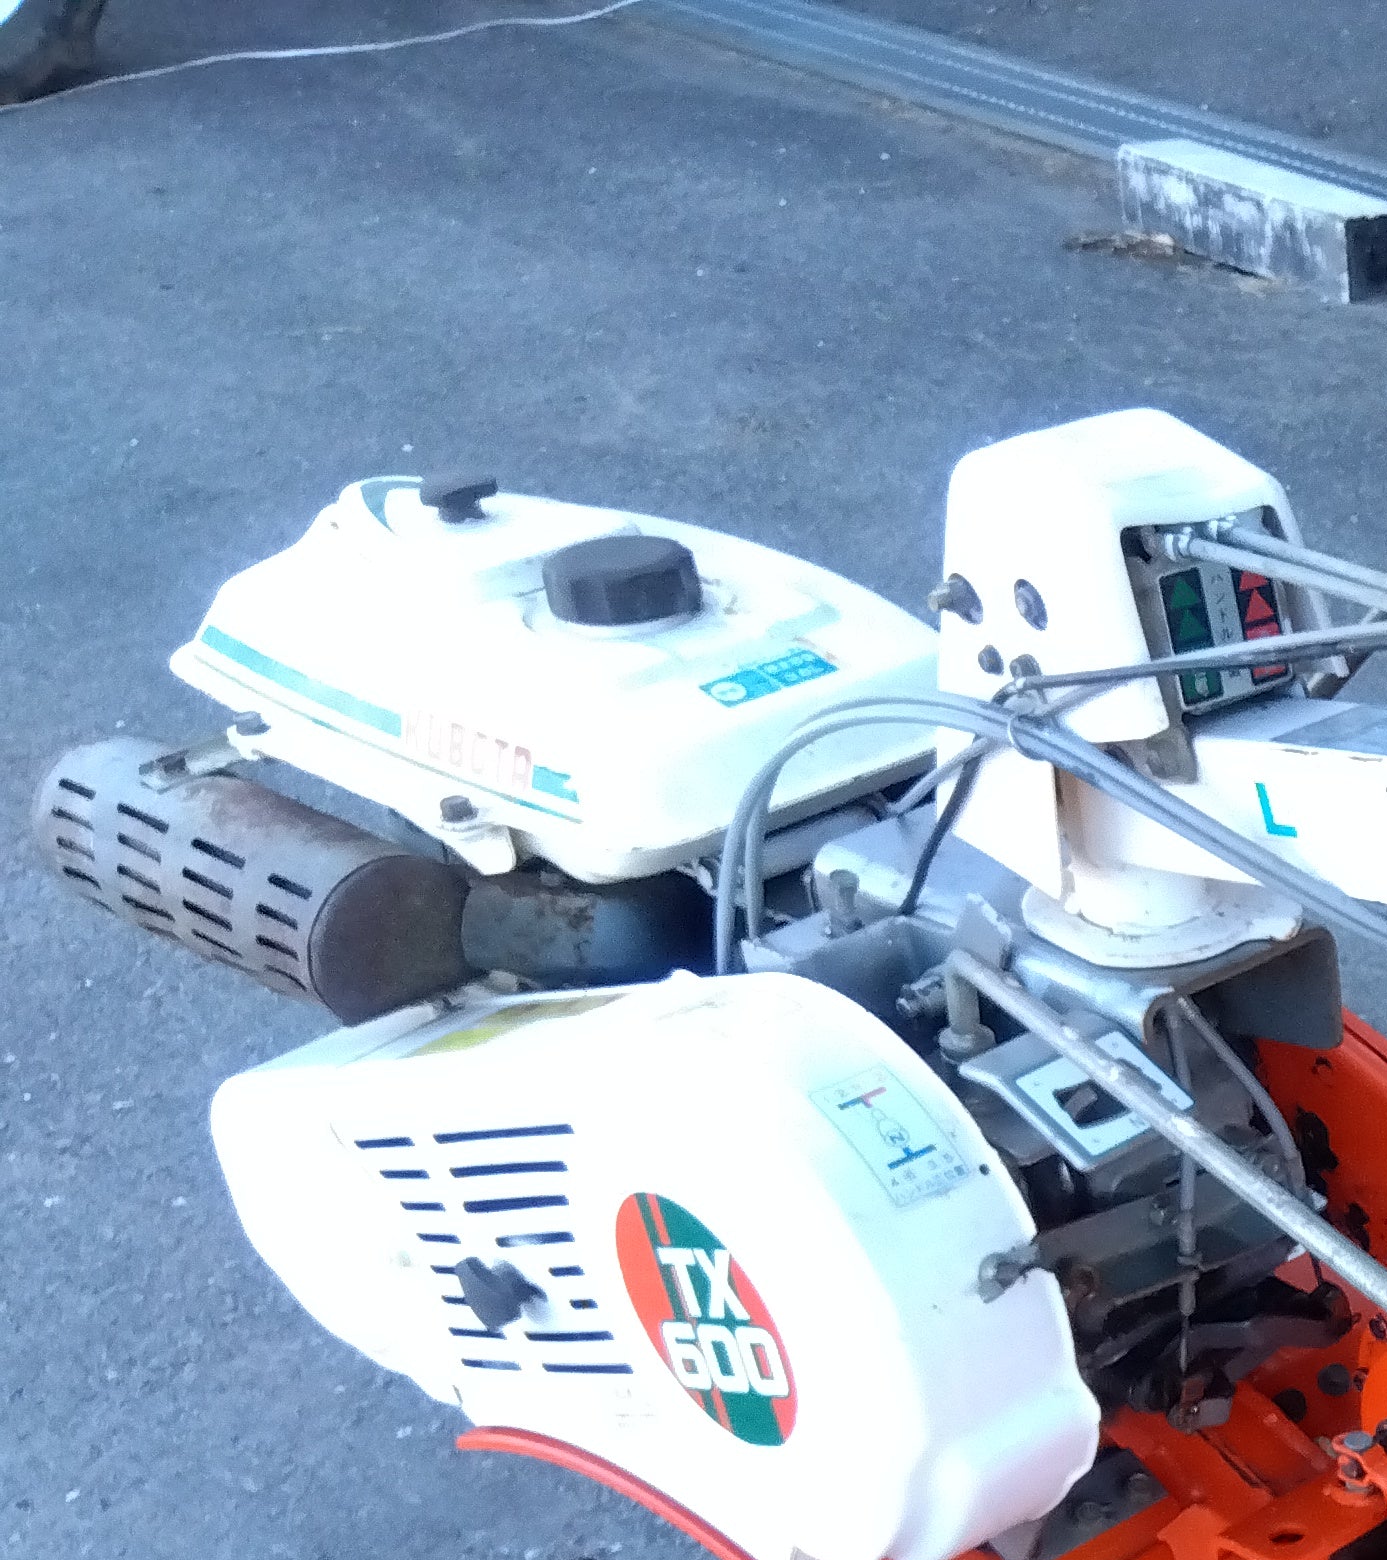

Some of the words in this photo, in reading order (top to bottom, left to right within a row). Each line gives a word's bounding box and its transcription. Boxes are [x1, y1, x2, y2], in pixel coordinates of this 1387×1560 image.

[1255, 782, 1297, 837] L
[656, 1247, 751, 1321] TX
[660, 1320, 790, 1398] 600
